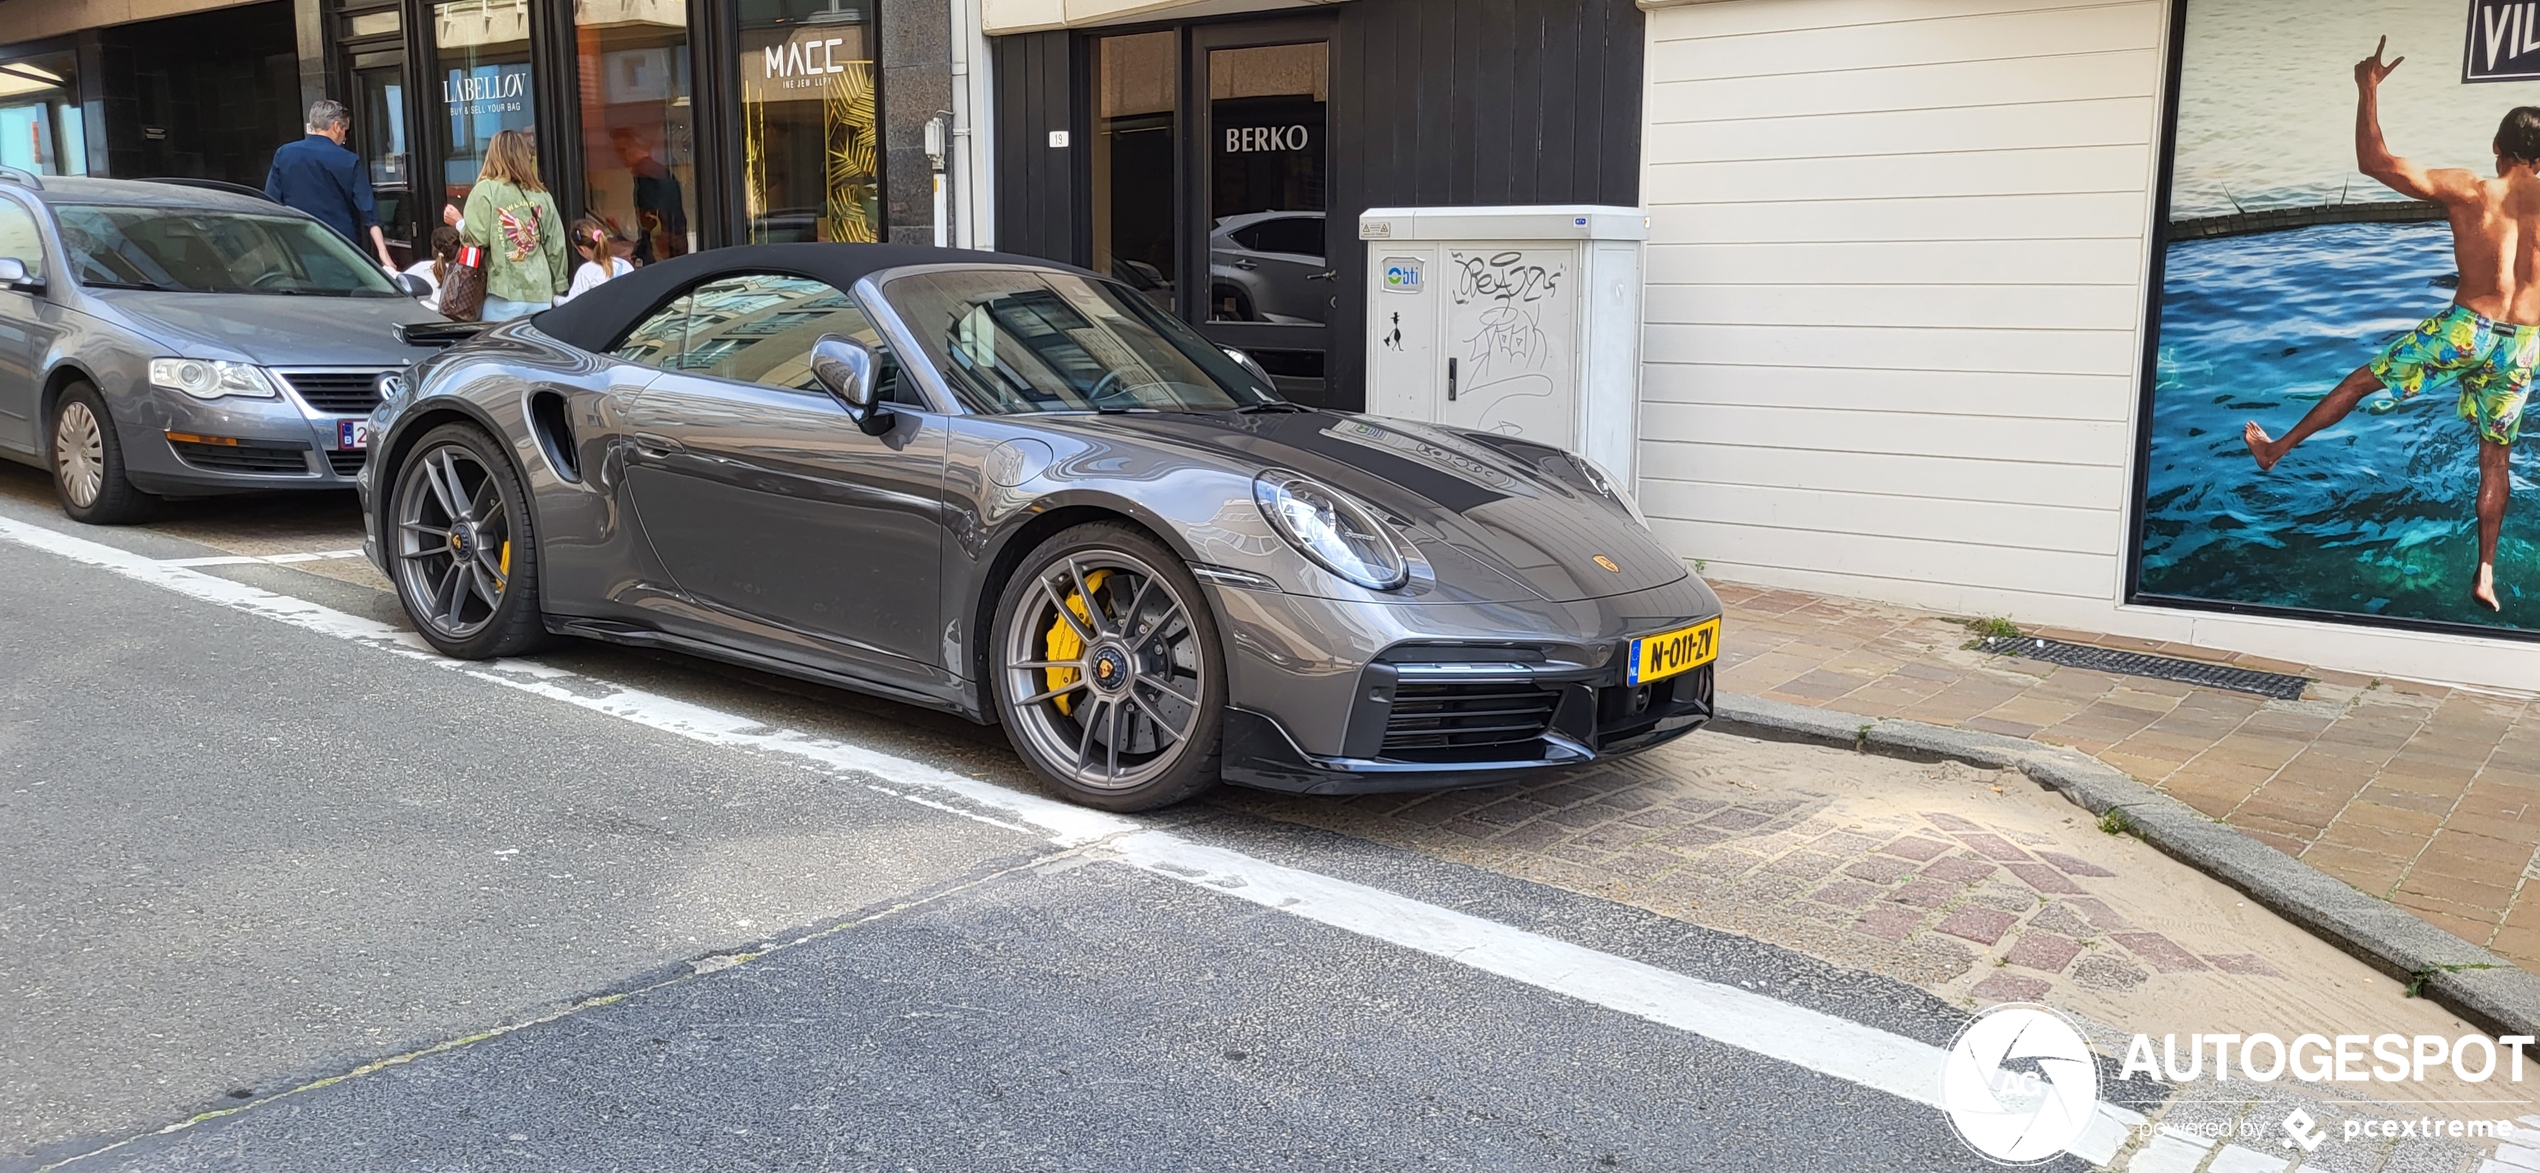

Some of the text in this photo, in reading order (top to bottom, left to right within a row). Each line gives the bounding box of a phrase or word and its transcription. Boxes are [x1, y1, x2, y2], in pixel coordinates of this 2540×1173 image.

[2483, 2, 2540, 72] VIL
[765, 37, 844, 79] MACC
[442, 72, 526, 103] LABELLOV
[450, 101, 521, 116] BUY & SELL YOUR BAG
[1055, 133, 1062, 145] 19
[1226, 124, 1308, 153] BERKO
[344, 435, 352, 445] B
[1650, 626, 1714, 674] N-011-ZV
[1629, 666, 1638, 677] NL
